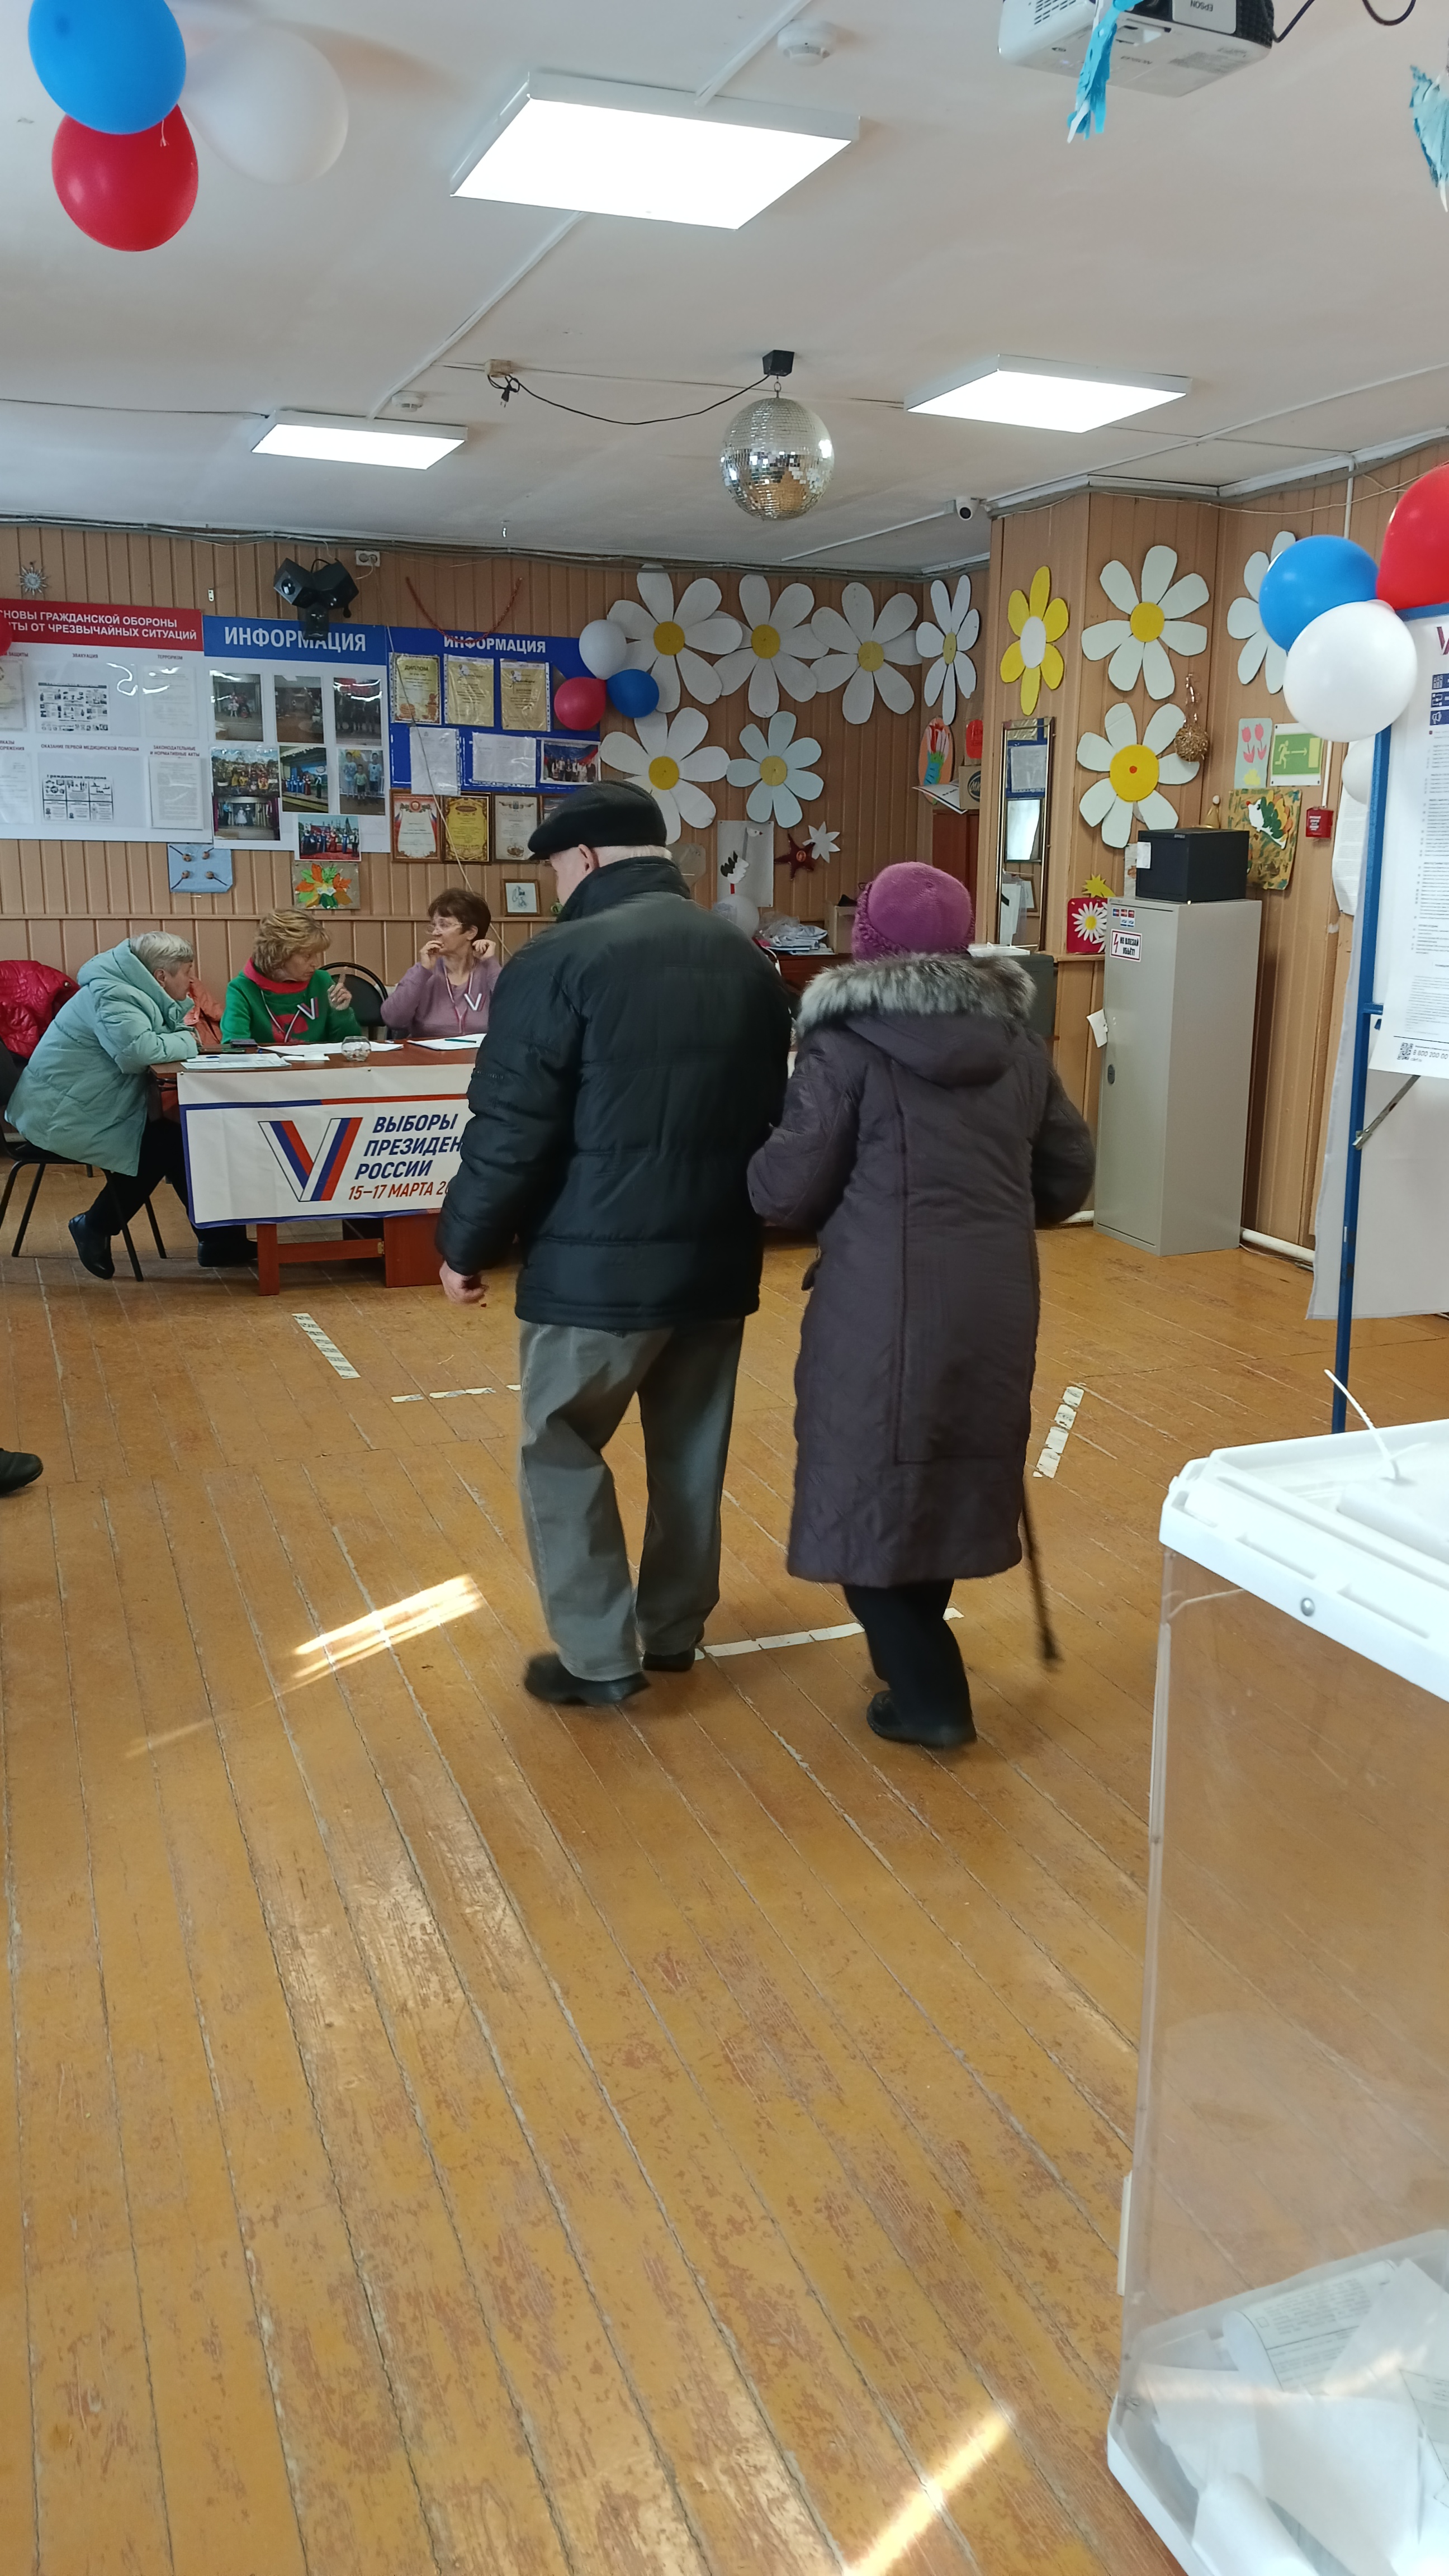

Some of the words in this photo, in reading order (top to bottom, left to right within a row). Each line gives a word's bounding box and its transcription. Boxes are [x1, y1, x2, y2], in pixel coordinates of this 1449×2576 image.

[1190, 0, 1213, 11] EPSON
[0, 609, 37, 620] НОВЫ
[40, 612, 120, 624] ГРАЖДАНСКОЙ
[122, 616, 177, 628] ОБОРОНЫ
[8, 622, 28, 631] ТЫ
[31, 623, 45, 632] ОТ
[48, 624, 140, 637] ЧРЕЗВЫЧАЙНЫХ
[141, 628, 197, 641] СИТУАЦИЙ
[443, 635, 546, 655] ИНФОРМАЦИЯ
[1125, 937, 1138, 946] ВЛЕЗАЙ
[372, 1113, 459, 1133] ВЫБОРЫ
[354, 1159, 433, 1180] РОССИИ
[387, 1181, 434, 1198] МАРТА
